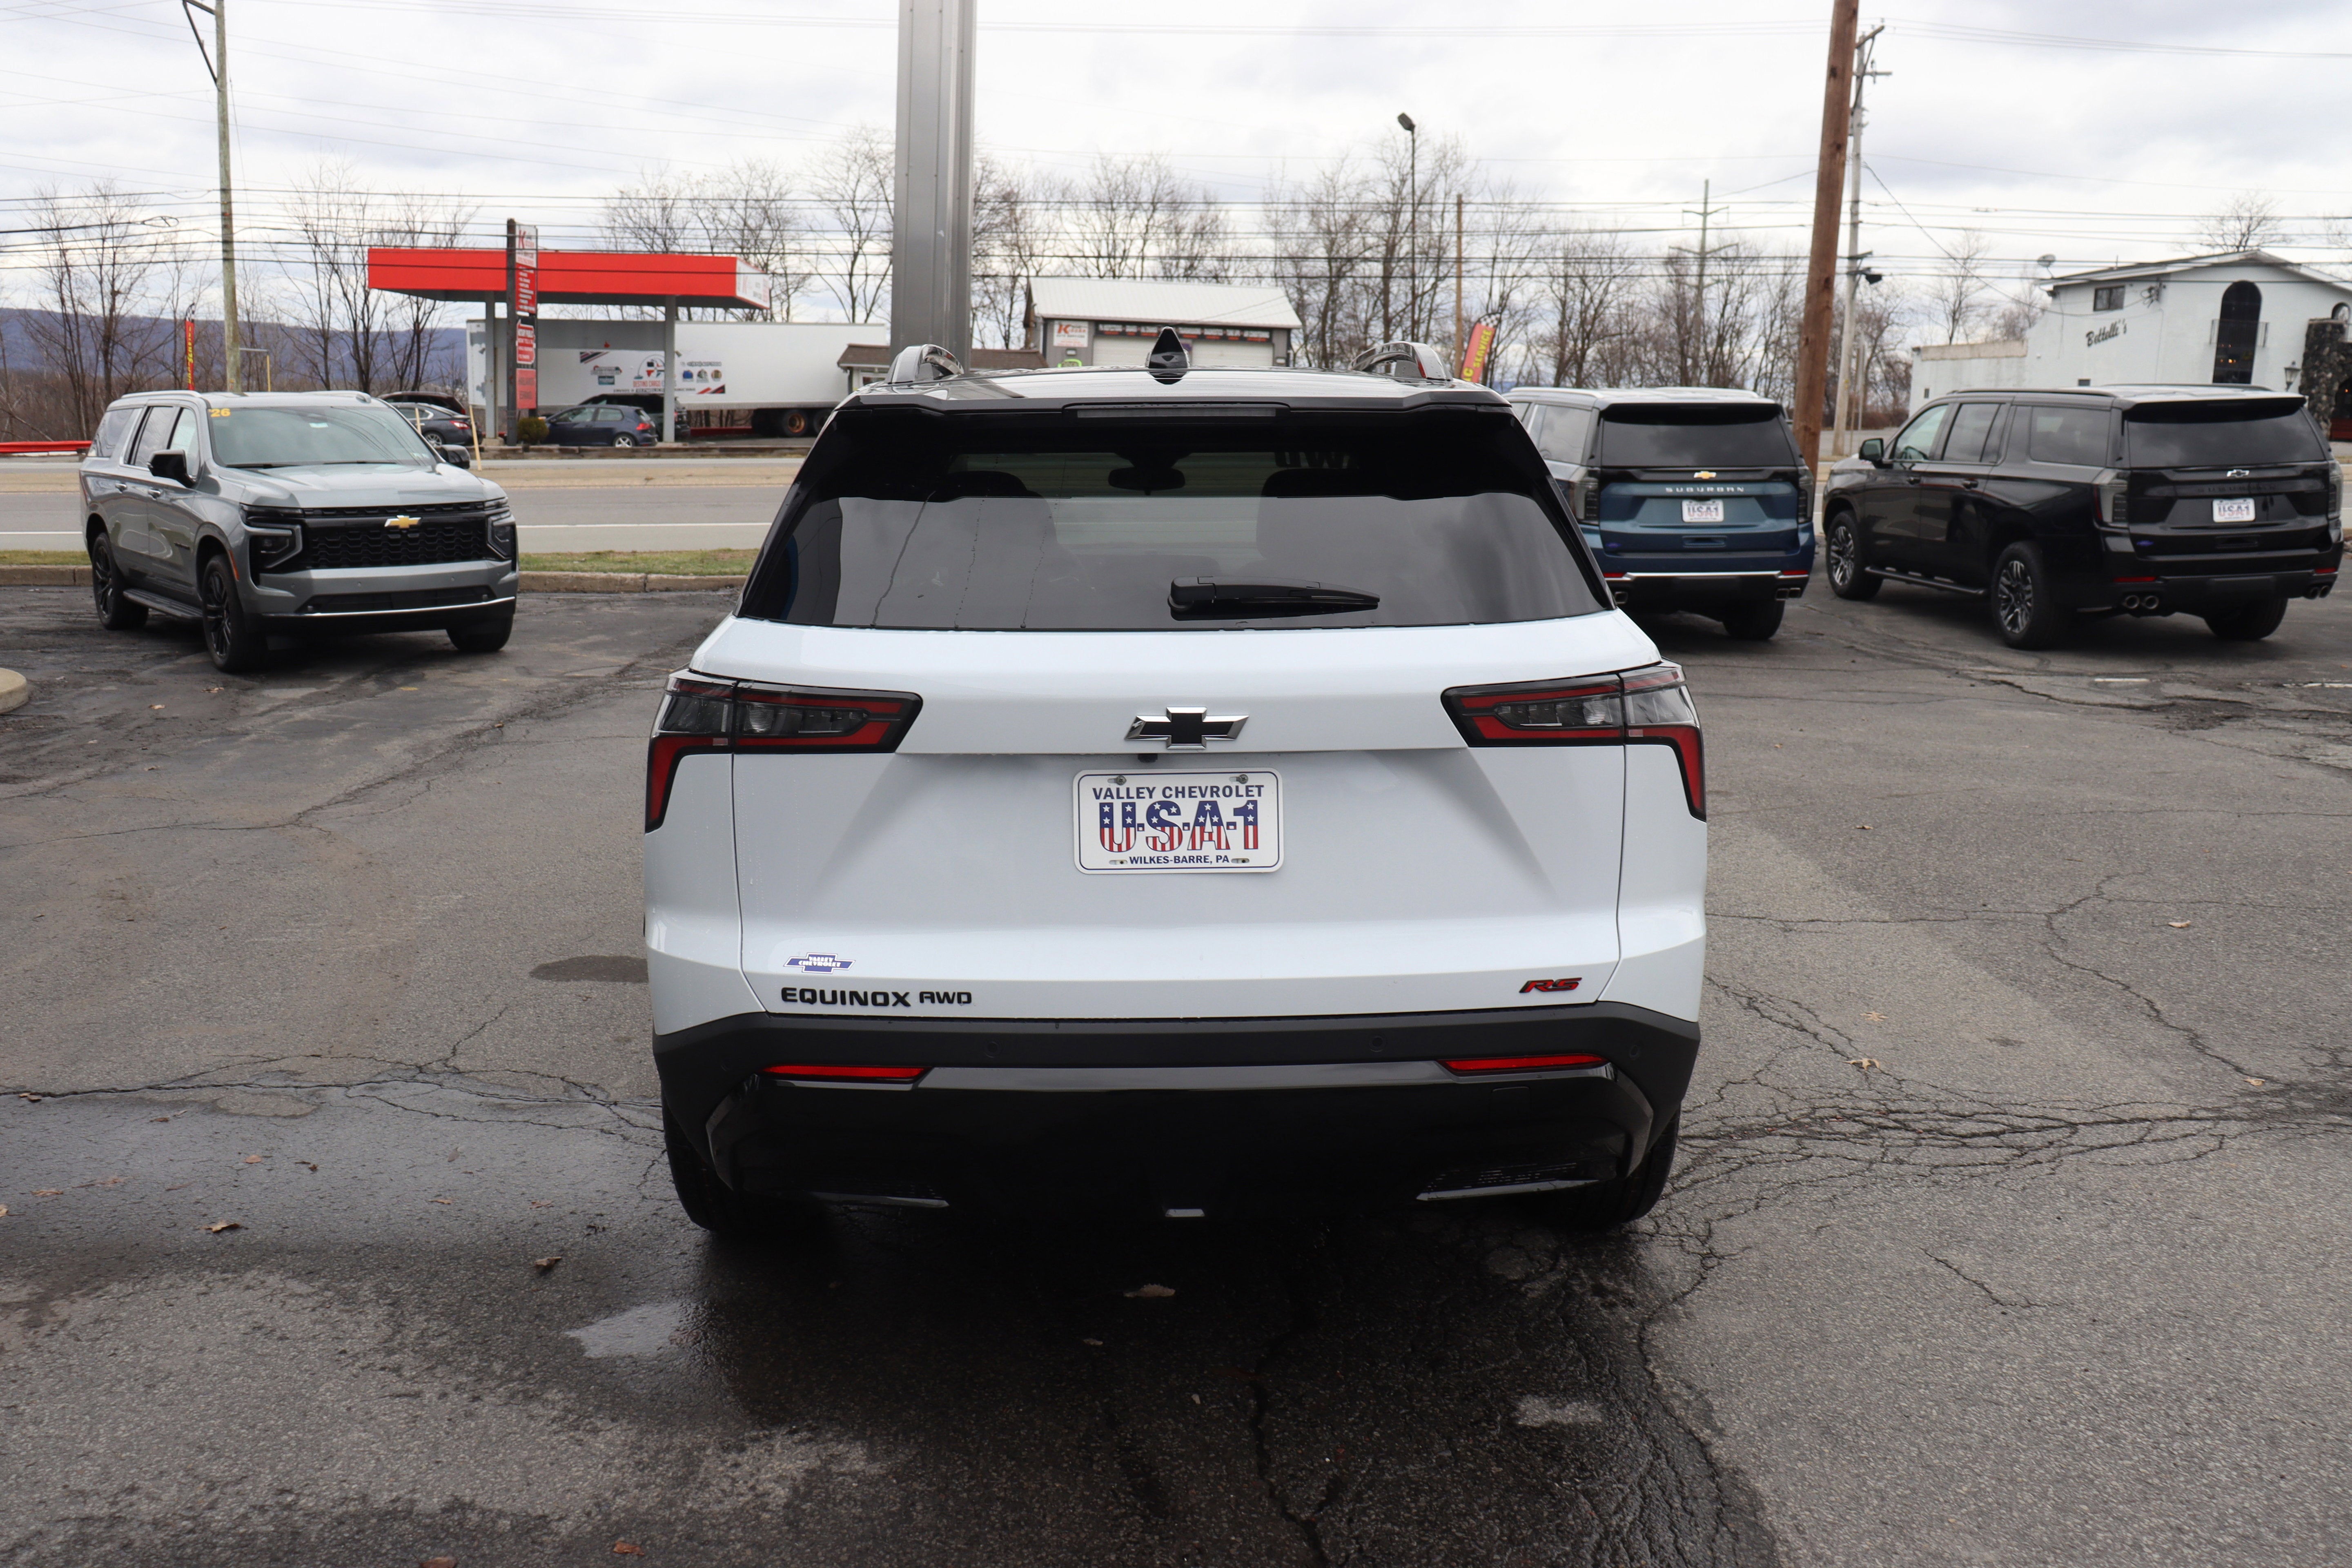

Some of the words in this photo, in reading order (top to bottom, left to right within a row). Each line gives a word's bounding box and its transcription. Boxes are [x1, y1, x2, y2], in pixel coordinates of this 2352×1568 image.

[1473, 329, 1492, 368] SERVICE
[207, 408, 231, 417] '26
[1092, 786, 1156, 800] VALLEY
[1162, 785, 1264, 799] CHEVROLET
[1129, 855, 1212, 865] WILKES-BARRE,
[1215, 855, 1229, 863] PA
[1519, 977, 1582, 993] RS
[781, 987, 911, 1007] EQUINOX
[919, 991, 972, 1004] AWD
